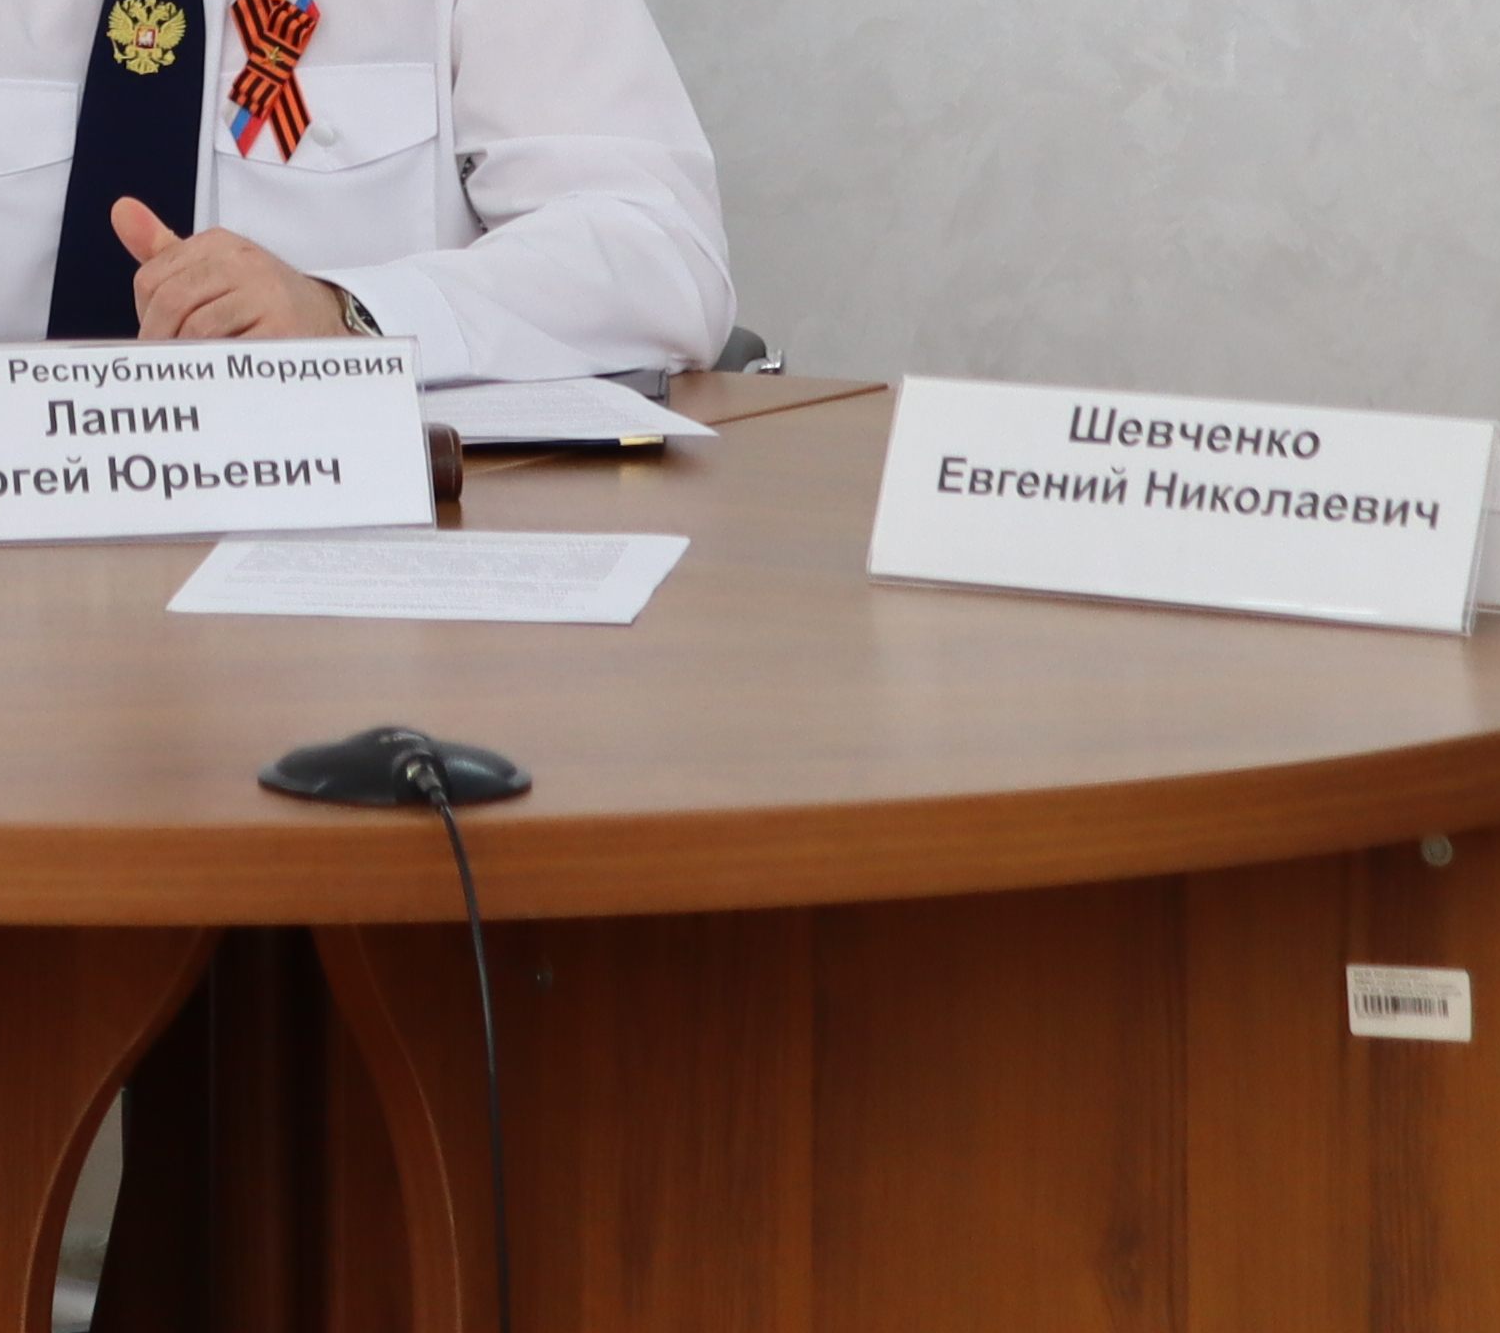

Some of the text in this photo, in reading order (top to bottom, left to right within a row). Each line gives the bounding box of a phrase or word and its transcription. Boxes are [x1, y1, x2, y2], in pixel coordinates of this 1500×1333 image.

[7, 356, 215, 388] Республики
[226, 353, 404, 384] Мордовия
[45, 399, 200, 437] Лапин
[1068, 405, 1321, 460] Шевченко
[107, 453, 341, 500] Юрьевич
[937, 456, 1440, 530] Евгений Николаевич
